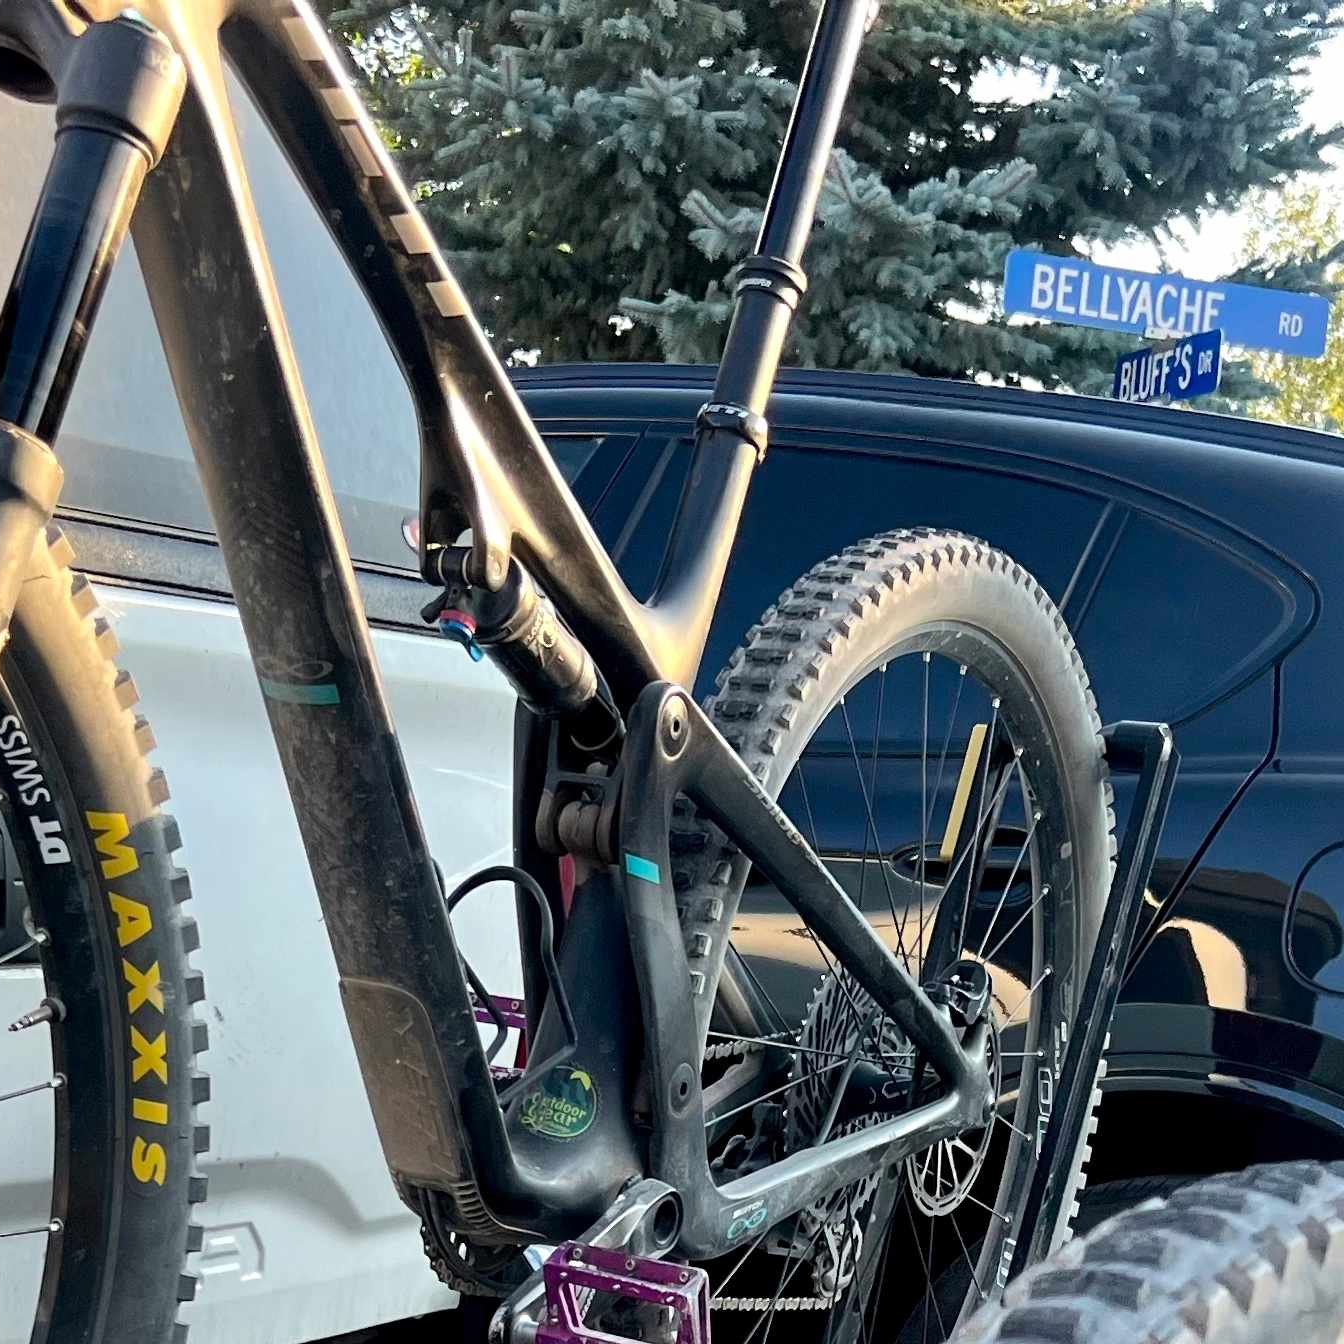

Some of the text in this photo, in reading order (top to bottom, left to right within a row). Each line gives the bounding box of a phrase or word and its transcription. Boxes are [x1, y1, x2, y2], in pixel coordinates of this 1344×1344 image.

[1030, 263, 1303, 338] BELLYACHE RD
[1119, 343, 1213, 401] BLUFF'S DR
[28, 815, 72, 865] DT
[84, 810, 169, 1187] MAXXIS
